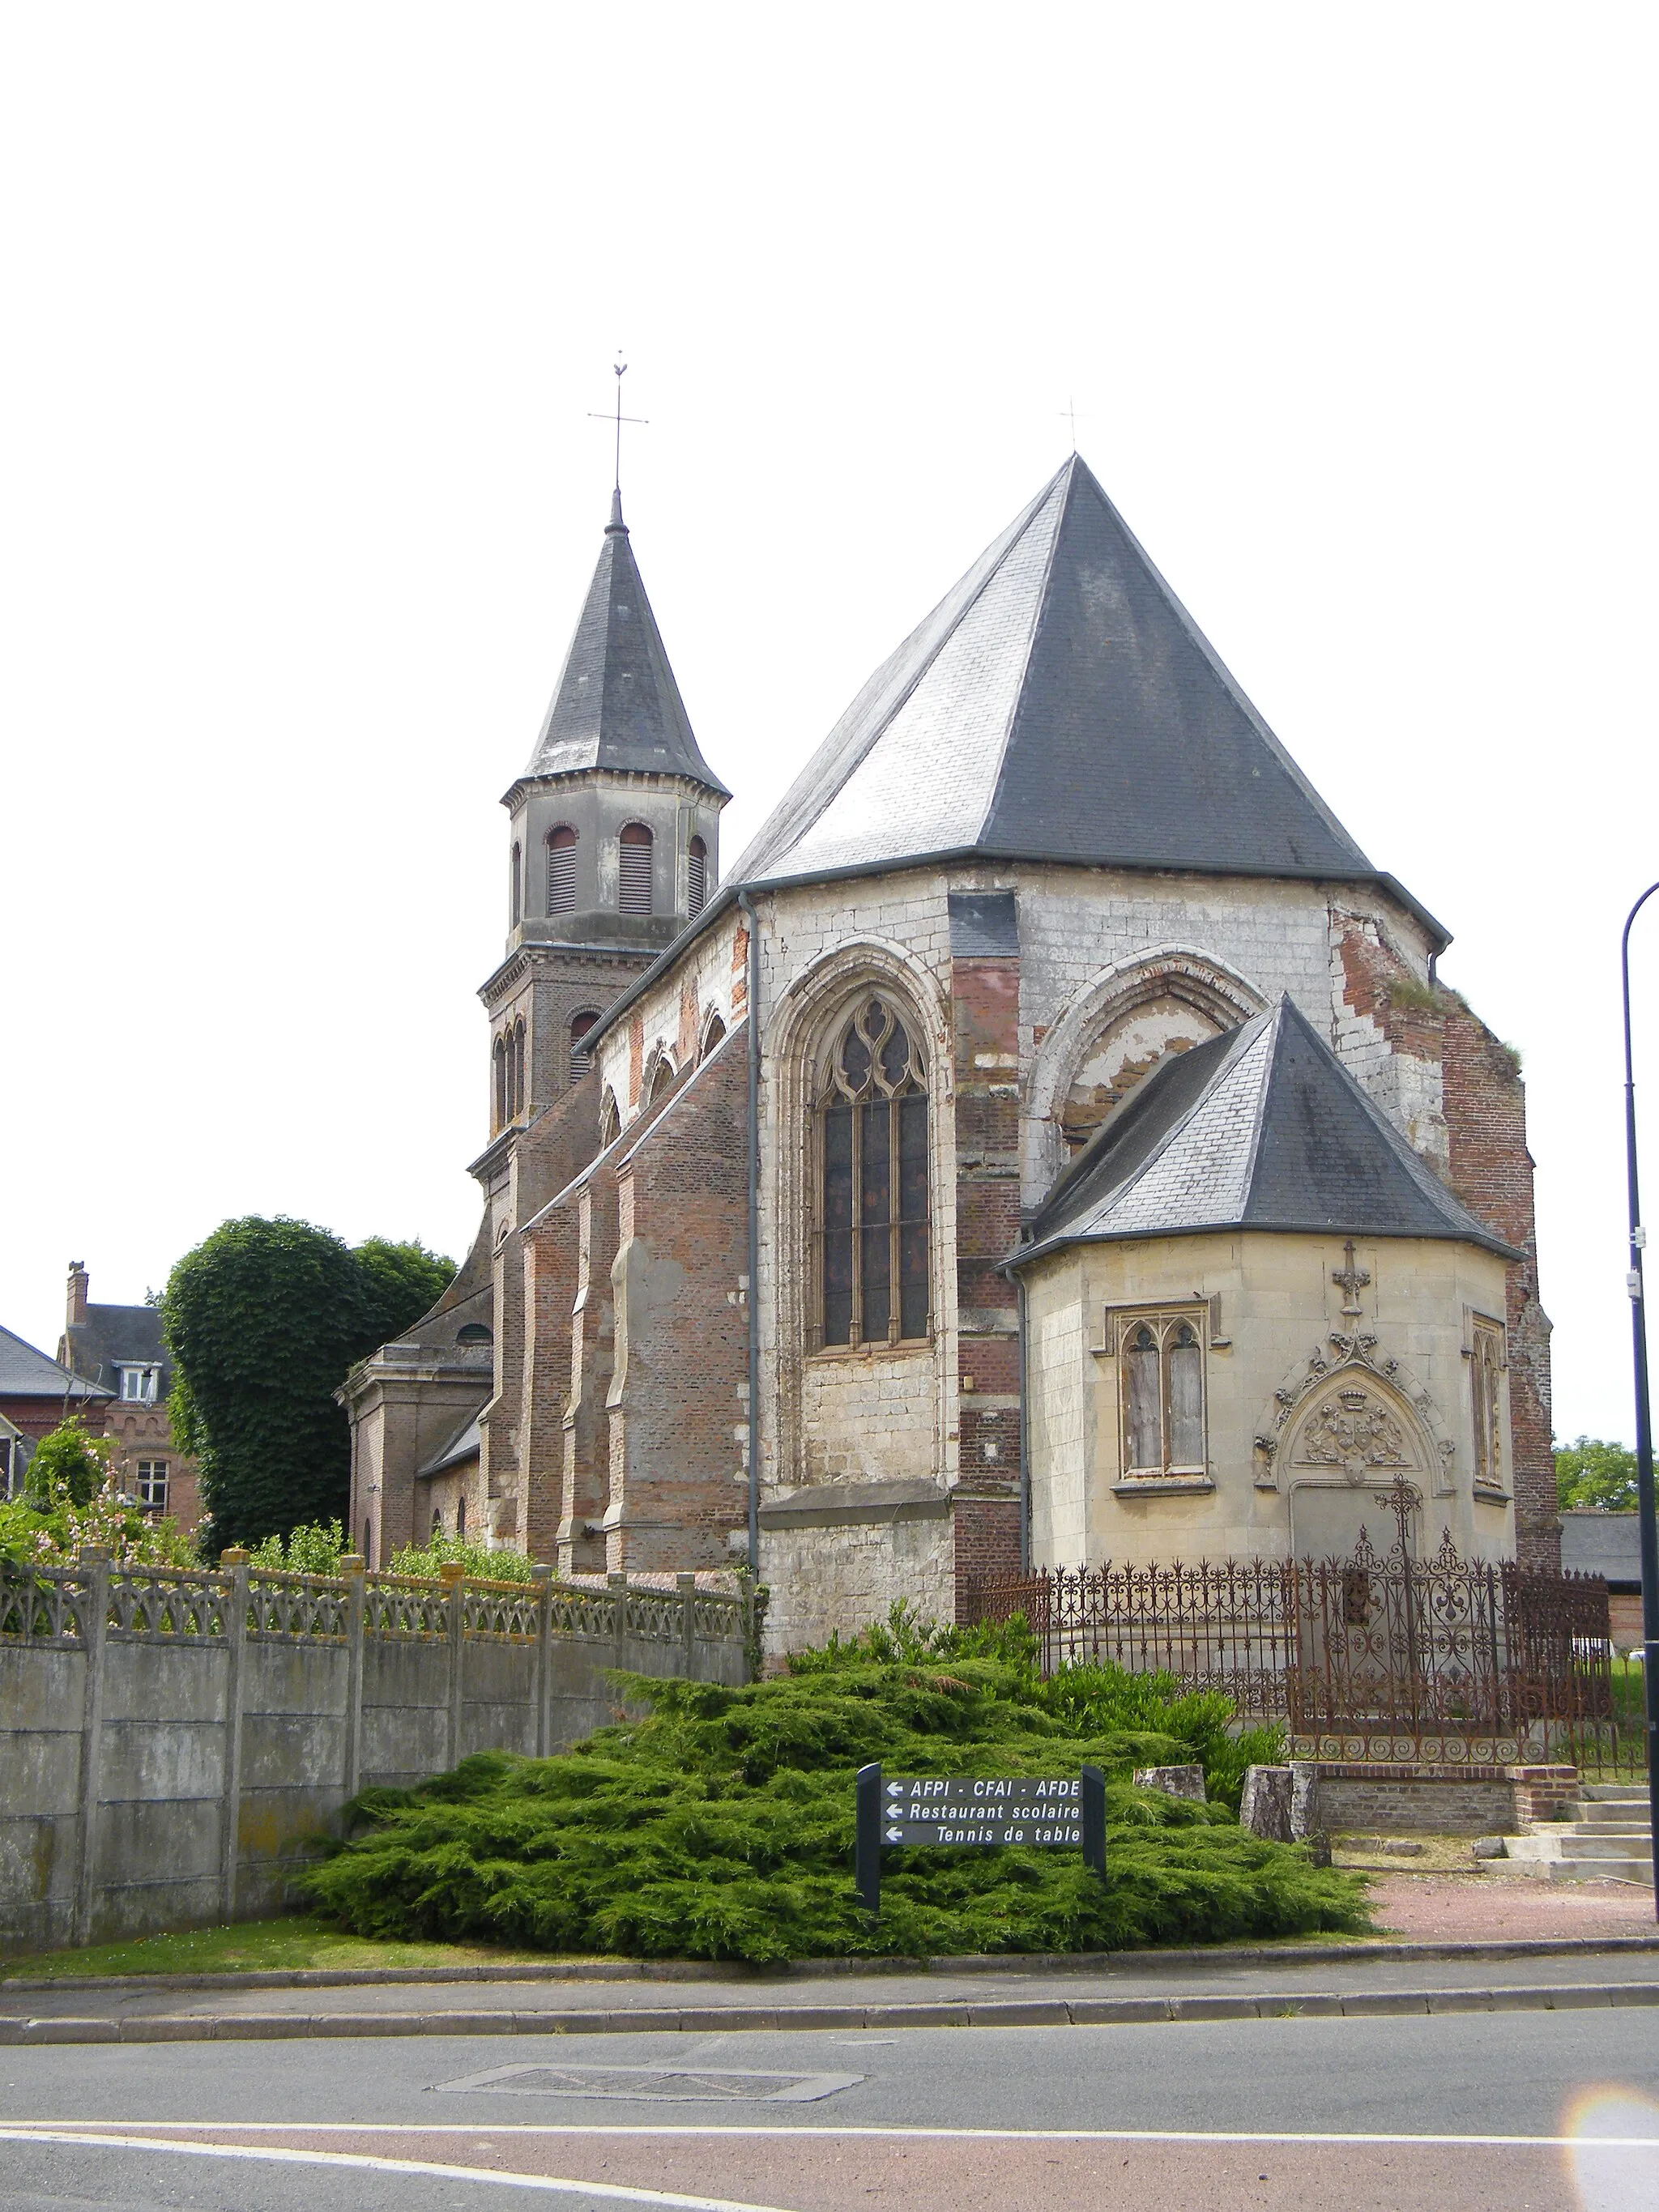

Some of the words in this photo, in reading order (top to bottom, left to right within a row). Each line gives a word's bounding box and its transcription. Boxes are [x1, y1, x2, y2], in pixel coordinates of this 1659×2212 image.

[910, 1780, 950, 1796] AFPI
[973, 1780, 1013, 1796] CFAI
[1035, 1780, 1080, 1796] AFDE
[909, 1803, 1004, 1819] Restaurant
[1012, 1803, 1080, 1819] scolaire
[937, 1826, 993, 1842] Tennis
[1004, 1826, 1024, 1842] de
[1034, 1826, 1080, 1842] table
